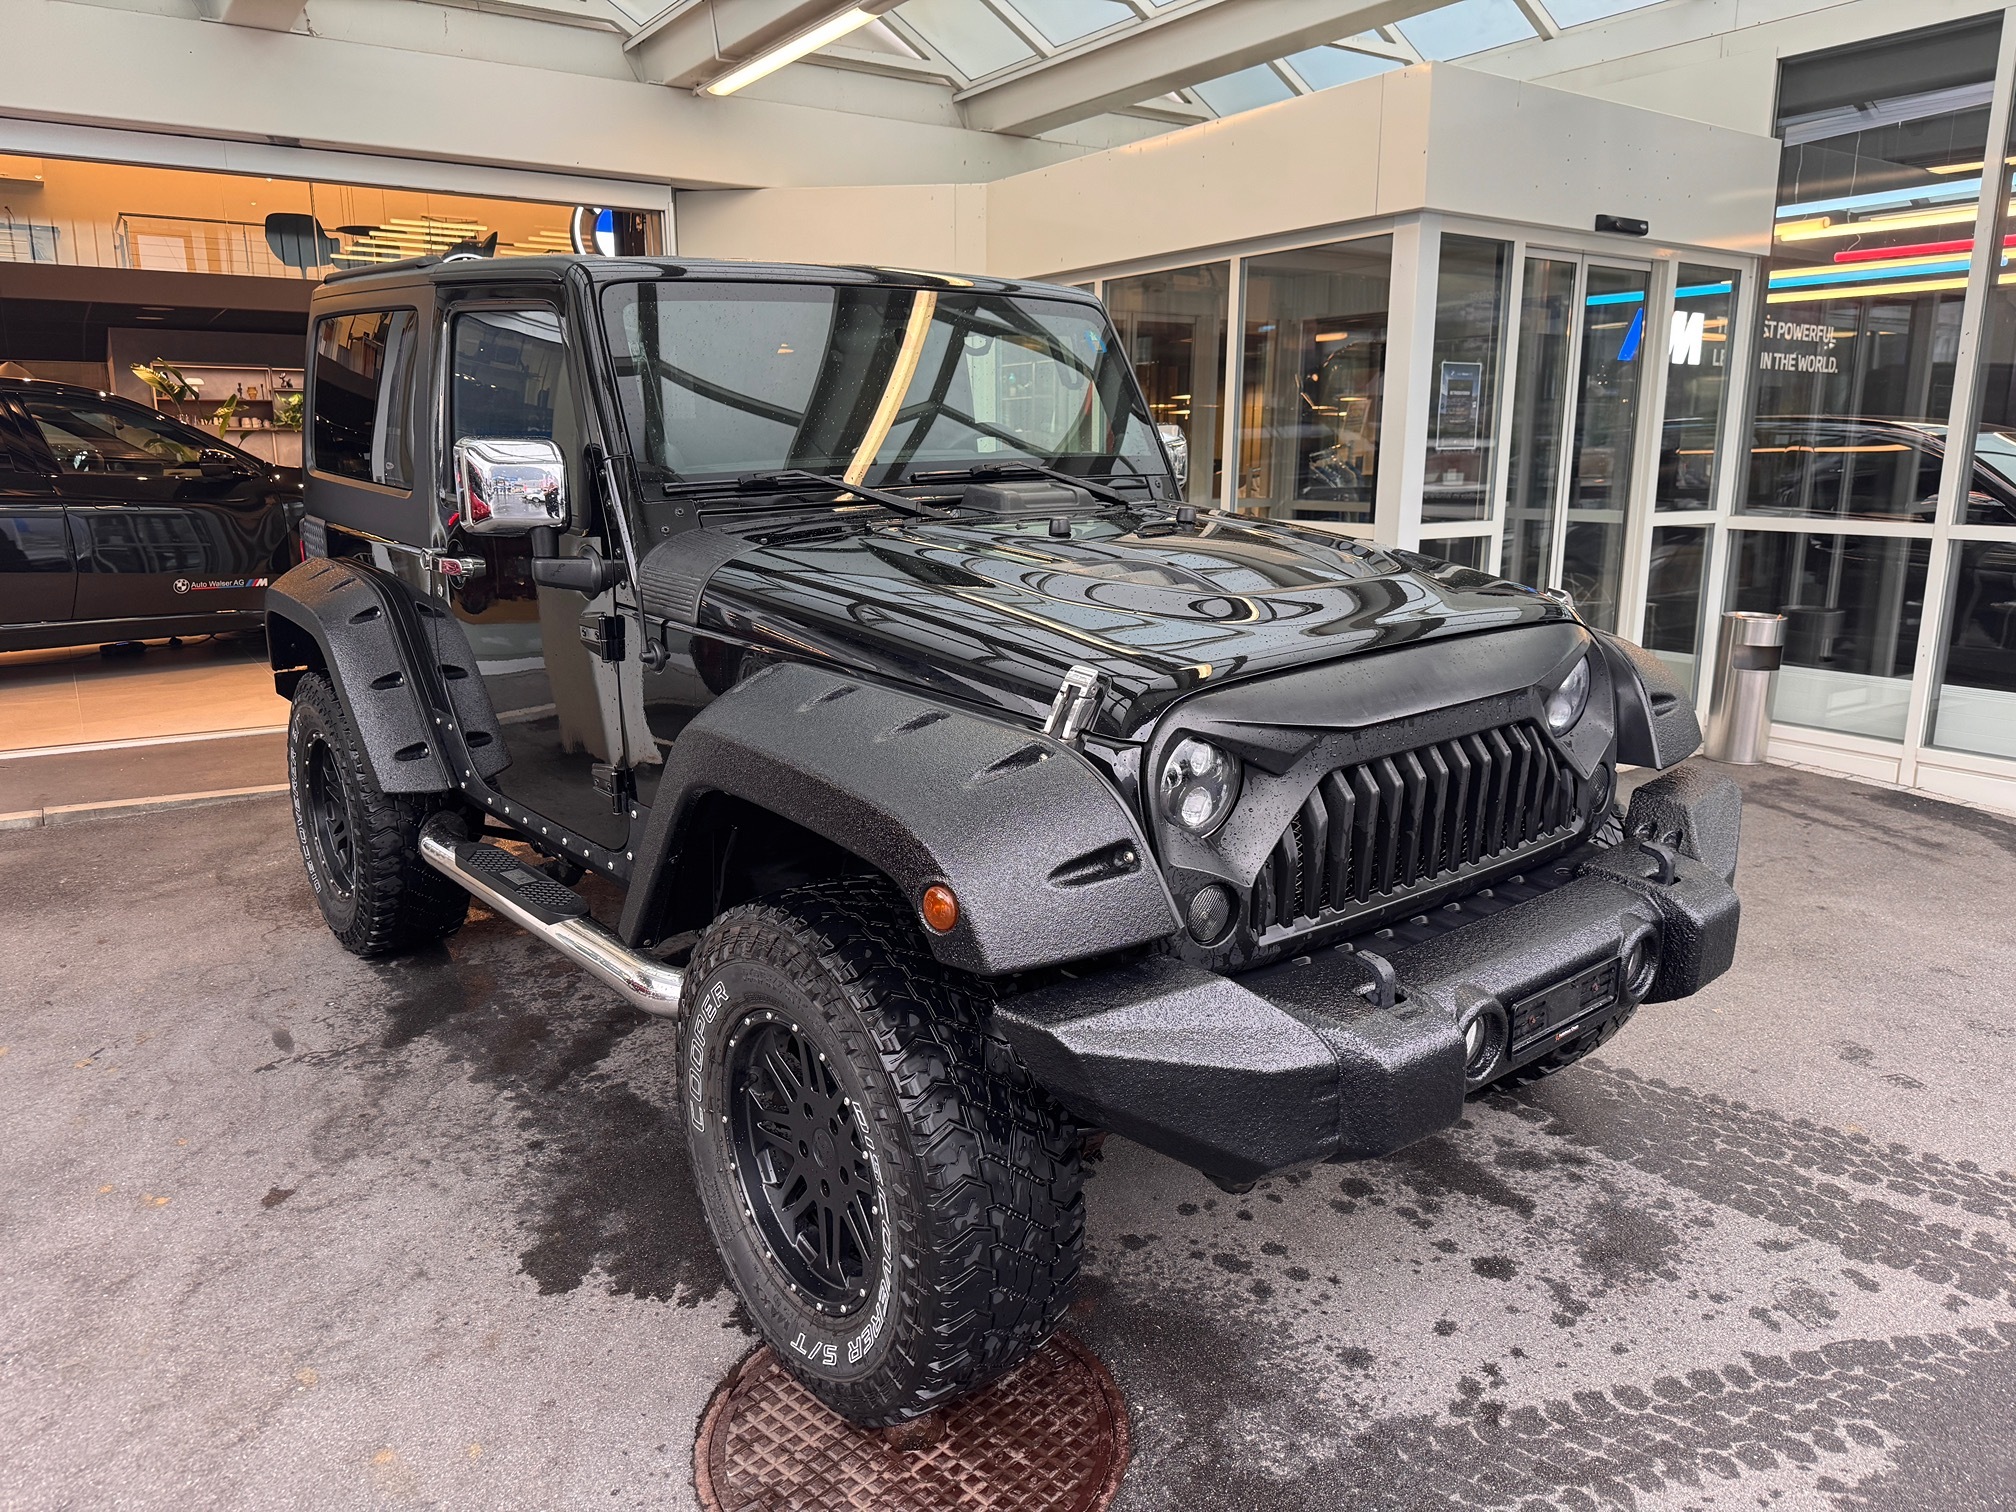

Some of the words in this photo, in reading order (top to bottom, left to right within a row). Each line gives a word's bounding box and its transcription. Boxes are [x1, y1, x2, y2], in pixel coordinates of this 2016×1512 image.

[1669, 310, 1705, 366] M
[1777, 321, 1837, 343] POWERFUL
[1760, 351, 1773, 370] IN
[1774, 353, 1797, 371] THE
[1797, 354, 1839, 374] WORLD.
[233, 578, 245, 586] AG
[689, 981, 729, 1133] COOPER
[848, 1101, 893, 1364] DISCOVERER
[790, 1332, 838, 1366] S/T
